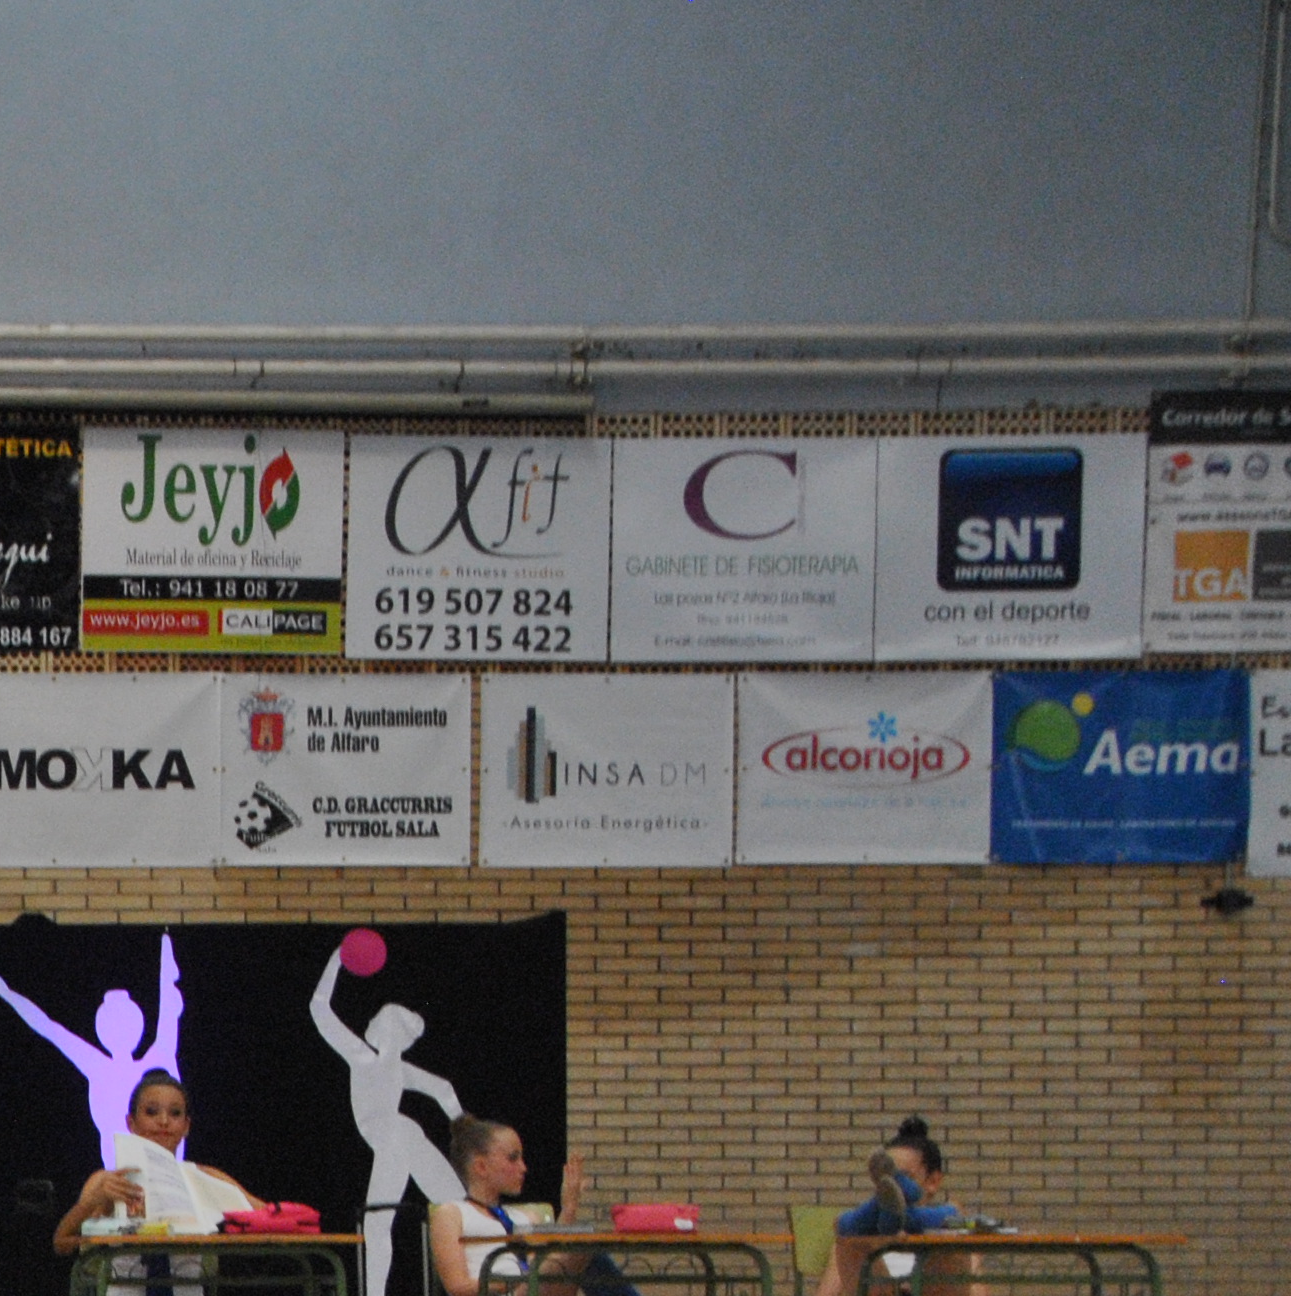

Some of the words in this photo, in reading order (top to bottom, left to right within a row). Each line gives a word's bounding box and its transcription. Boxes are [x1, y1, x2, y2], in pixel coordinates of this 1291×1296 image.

[120, 433, 301, 547] Jeyjo
[955, 516, 1065, 562] SNT
[126, 548, 177, 567] Material
[180, 549, 194, 566] de
[197, 549, 237, 568] oficina
[240, 555, 247, 570] y
[251, 550, 302, 570] Reciclaje
[715, 556, 737, 576] DE
[748, 556, 859, 577] FISIOTERAPIA
[387, 565, 433, 577] dance
[439, 566, 451, 577] &
[456, 566, 508, 578] fitness
[514, 565, 565, 578] studio
[1173, 567, 1250, 599] TGA
[120, 580, 160, 597] Tel.:
[169, 580, 203, 598] 941
[215, 580, 236, 598] 18
[244, 581, 267, 598] 08
[275, 581, 299, 598] 77
[375, 587, 435, 615] 619
[445, 588, 503, 616] 507
[513, 588, 573, 616] 824
[924, 605, 965, 622] con
[973, 602, 993, 621] el
[1001, 601, 1091, 624] deporte
[90, 611, 200, 630] www.jeyjo.es
[0, 627, 32, 647] 884
[39, 627, 72, 647] 167
[374, 624, 434, 651] 657
[444, 624, 502, 652] 315
[512, 625, 573, 652] 422
[307, 706, 338, 727] M.I.
[343, 706, 448, 731] Ayuntamiento
[307, 732, 325, 752] de
[331, 732, 380, 752] Alfaro
[1082, 728, 1241, 775] Aema
[785, 732, 944, 781] alcorioja
[563, 762, 646, 787] INSA
[660, 762, 707, 786] DM
[312, 796, 341, 815] C.D.
[344, 796, 453, 815] GRACCURRIS
[325, 820, 393, 838] FUTBOL
[395, 820, 440, 838] SALA
